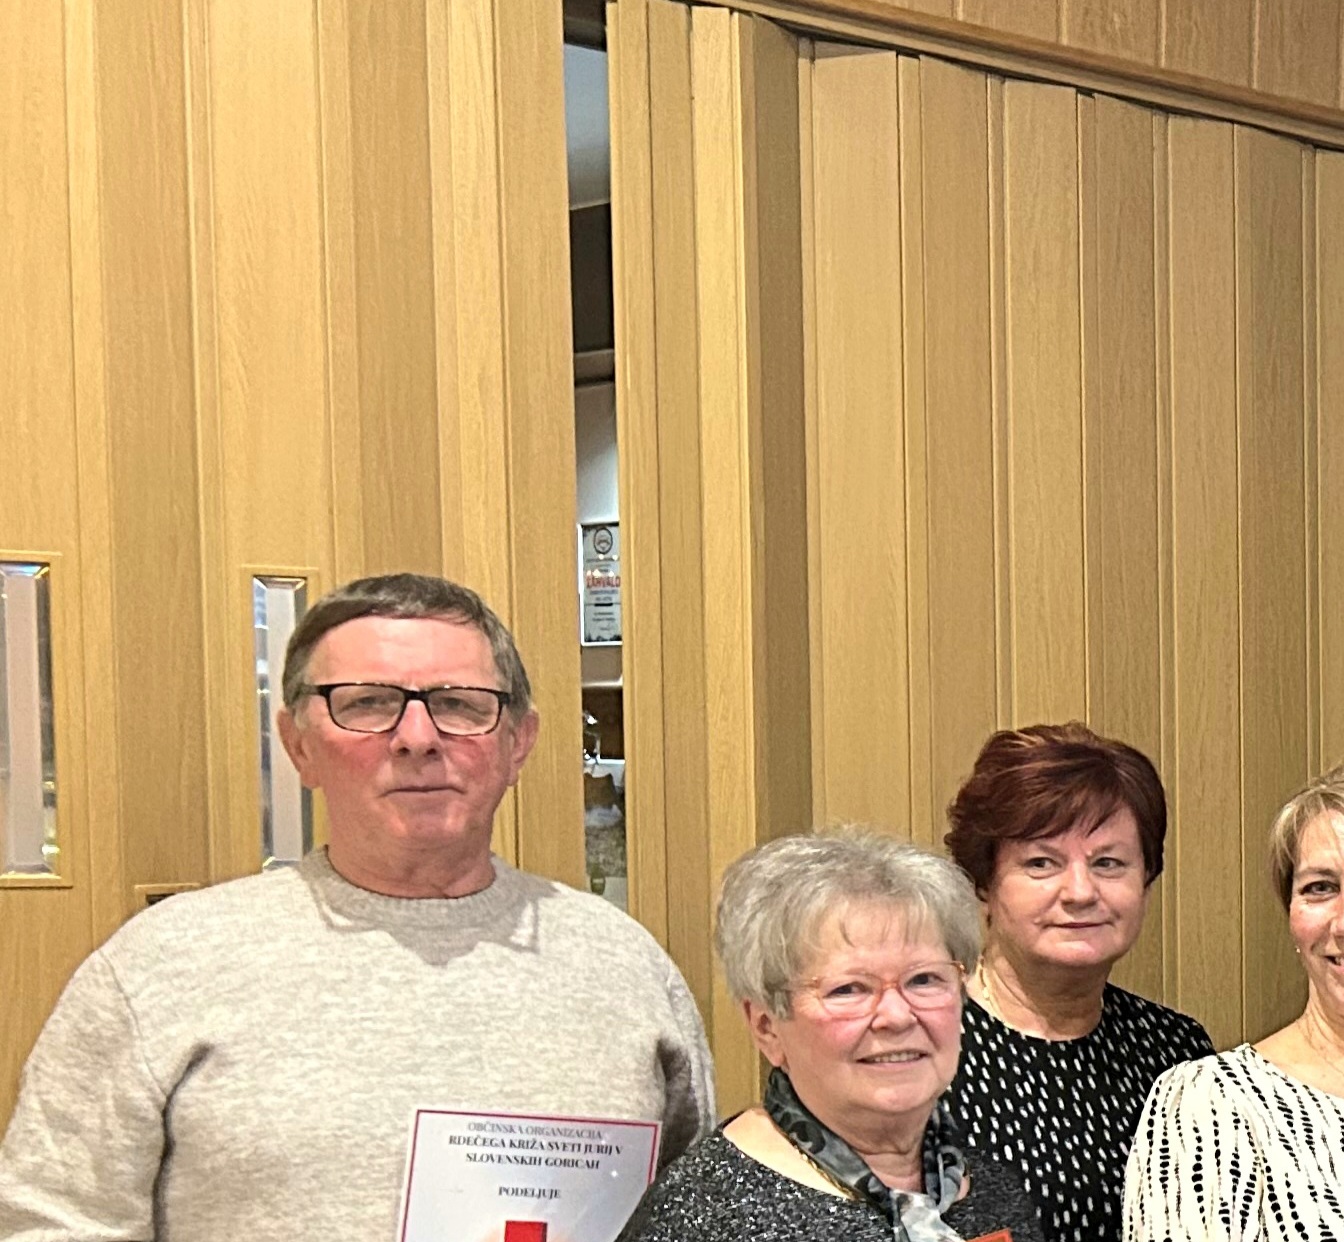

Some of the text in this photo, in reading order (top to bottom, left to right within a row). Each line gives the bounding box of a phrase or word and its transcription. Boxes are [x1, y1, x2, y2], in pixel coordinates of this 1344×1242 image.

[468, 1122, 602, 1140] OBČINSKA ORGANIZACIJA
[449, 1135, 623, 1156] RDEČEGA KRIŽA SVETI JURIJ V
[466, 1153, 600, 1169] SLOVENSKIH GORICAH
[499, 1186, 562, 1200] PODELJUJE
